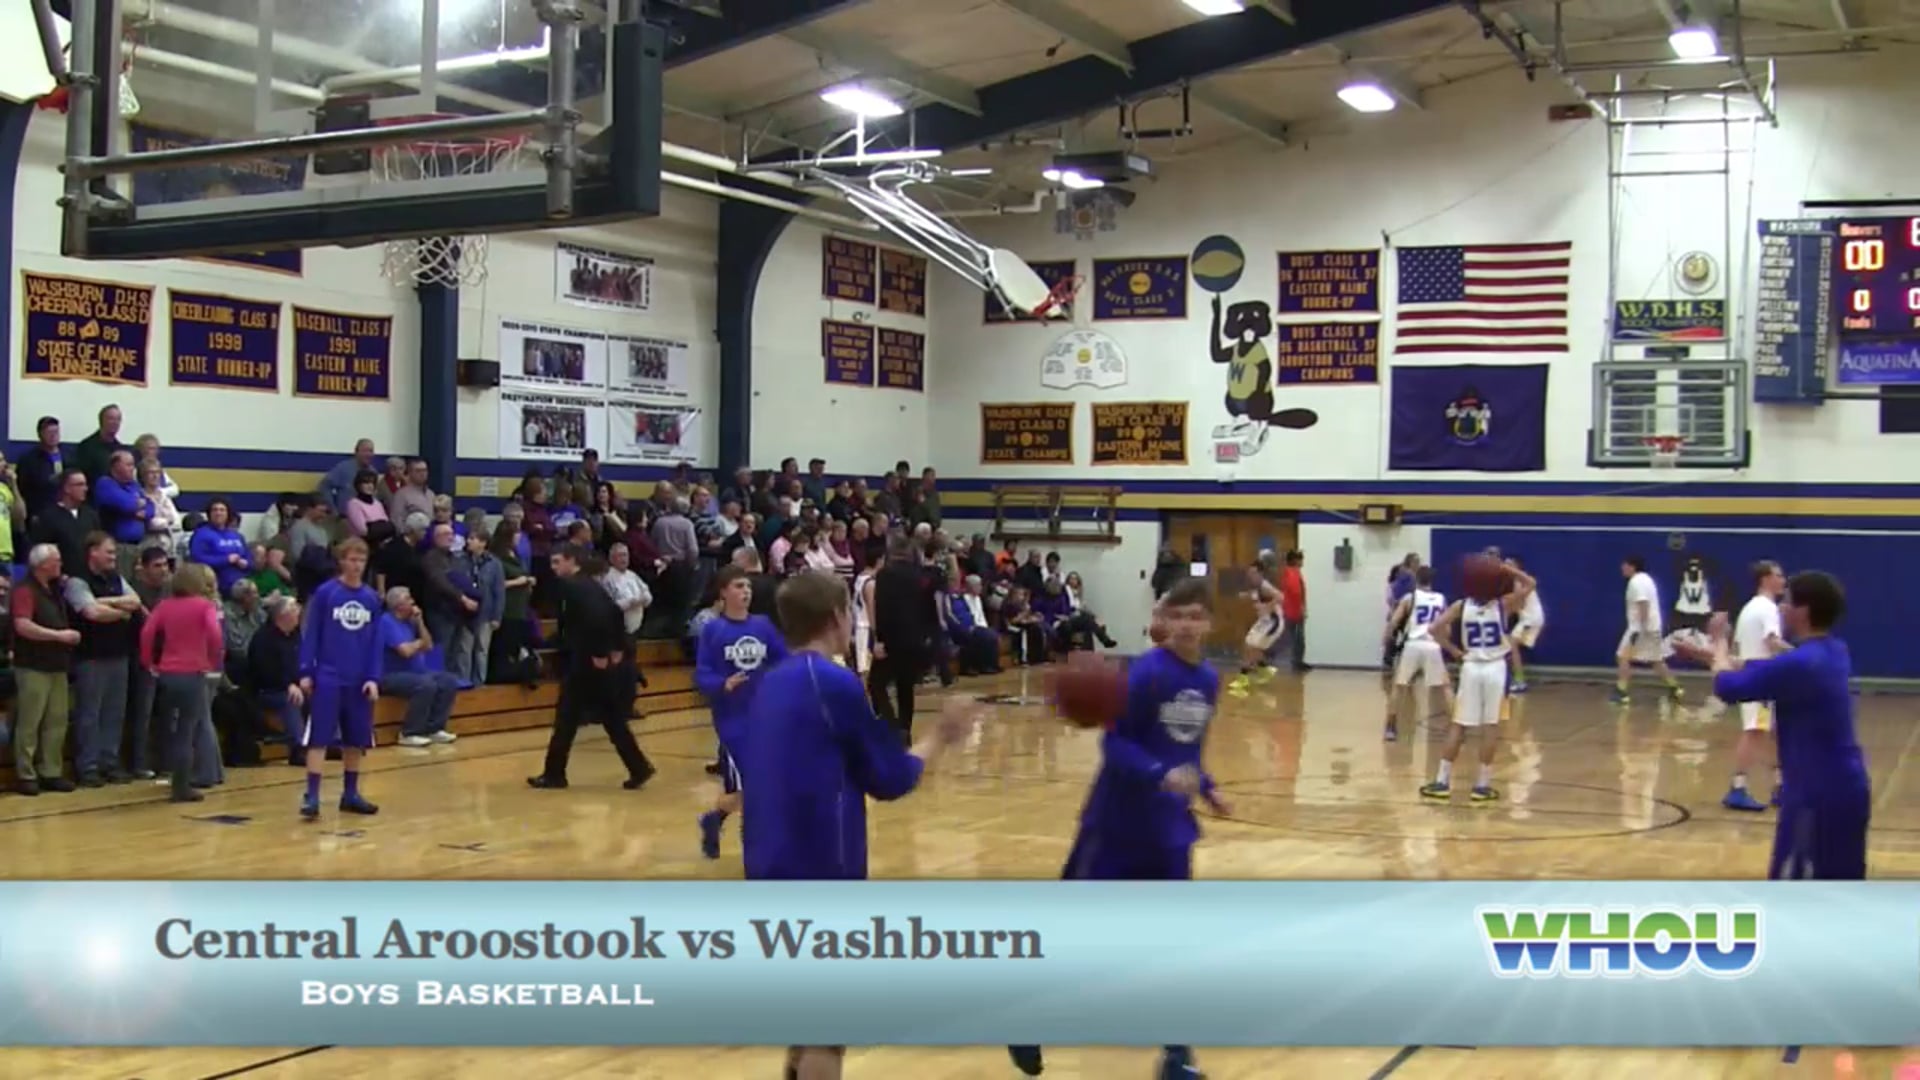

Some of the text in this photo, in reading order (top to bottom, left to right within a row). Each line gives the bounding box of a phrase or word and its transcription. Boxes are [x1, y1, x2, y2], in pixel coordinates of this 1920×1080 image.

[1323, 254, 1353, 266] CLASS
[1845, 240, 1885, 271] 00
[1298, 268, 1358, 280] BASKETBALL
[28, 278, 104, 302] WASHBURN
[1289, 281, 1368, 295] EASTERN MAINE
[28, 295, 91, 317] CHEERING
[96, 302, 137, 323] CLASS
[1854, 289, 1871, 311] 0
[240, 310, 266, 328] CLASS
[1619, 302, 1723, 318] W.D.H.S.
[57, 321, 76, 337] 88
[296, 312, 343, 334] BASEBALL
[350, 320, 379, 336] CLASS
[1322, 325, 1353, 338] CLASS
[37, 339, 137, 366] STATE OF MAINE
[329, 336, 356, 354] 1991
[1298, 339, 1358, 352] BASKETBALL
[50, 357, 125, 377] RUNNER-UP
[177, 355, 271, 379] STATE RUNNER-UP
[305, 353, 380, 374] EASTERN MAINE
[1340, 353, 1375, 366] LEAGUE
[1840, 348, 1920, 372] AQUAFINA
[1301, 368, 1354, 380] CHAMPIONS
[318, 374, 367, 393] RUNNER-UP
[1020, 420, 1054, 430] CLASS
[1129, 415, 1166, 427] CLASS
[1097, 440, 1142, 452] EASTERN
[1465, 621, 1501, 648] 23
